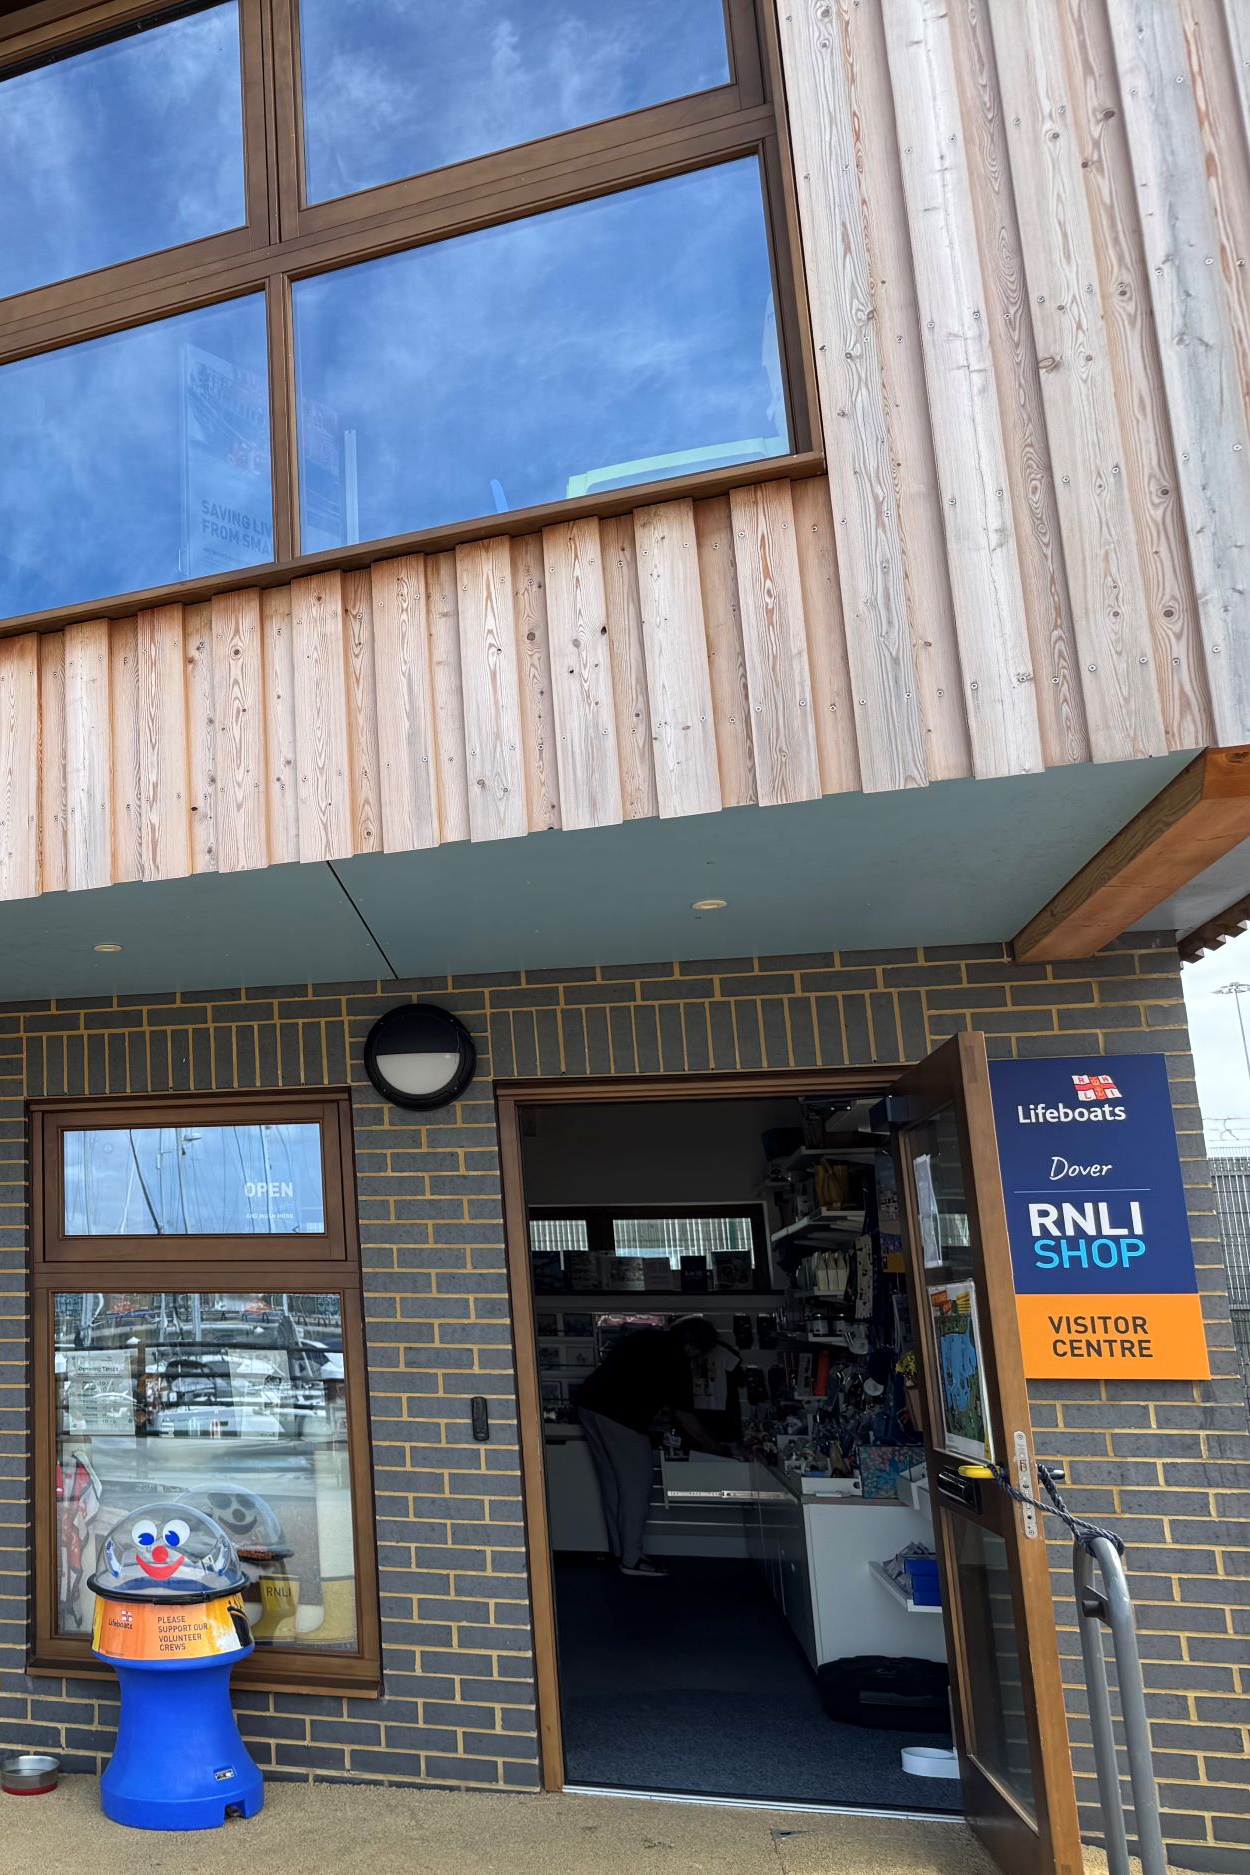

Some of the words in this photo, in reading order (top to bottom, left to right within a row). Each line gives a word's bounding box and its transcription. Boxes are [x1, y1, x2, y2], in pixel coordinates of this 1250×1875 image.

[201, 500, 251, 528] SAVING
[202, 518, 240, 544] FROM
[1017, 1102, 1127, 1124] Lifeboats
[1049, 1156, 1113, 1181] Dover
[244, 1182, 293, 1198] OPEN
[1028, 1201, 1144, 1237] RNLI
[1034, 1238, 1146, 1269] SHOP
[1048, 1315, 1149, 1335] VISITOR
[1052, 1339, 1154, 1358] CENTRE
[266, 1586, 291, 1598] RNLI
[108, 1618, 133, 1630] Lifeboats
[157, 1616, 186, 1624] PLEASE
[158, 1624, 192, 1633] SUPPORT
[193, 1622, 208, 1631] OUR
[159, 1633, 202, 1643] VOLUNTEER
[159, 1643, 186, 1651] CREWS
